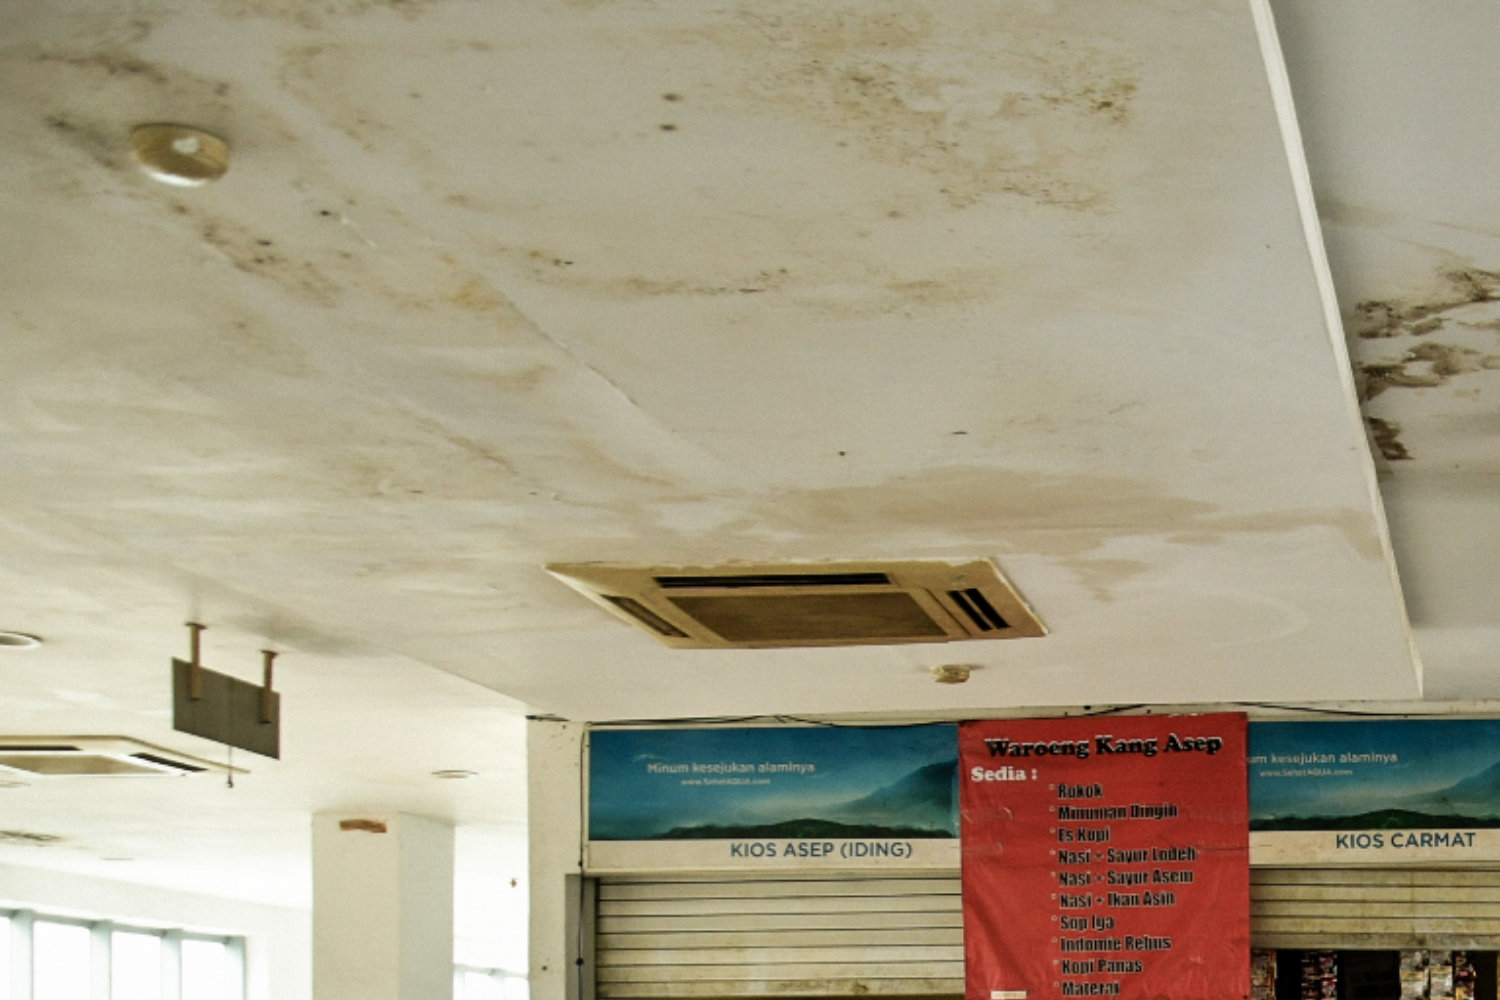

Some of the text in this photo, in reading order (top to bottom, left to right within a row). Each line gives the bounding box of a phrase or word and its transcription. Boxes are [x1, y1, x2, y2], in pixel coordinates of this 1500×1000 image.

[984, 733, 1223, 758] Waroeng Kang Asep
[1272, 753, 1335, 765] kesejukan
[1339, 752, 1398, 765] alaminya
[647, 761, 816, 775] Minum kesejukan alaminya
[971, 766, 1027, 782] Sedia
[1057, 784, 1104, 799] Rokok
[1057, 803, 1179, 821] Minuman Dingin
[1057, 826, 1110, 842] Es Kopi
[1336, 832, 1476, 849] KIOS CARMAT
[730, 842, 913, 859] KIOS ASEP (IDING)
[1058, 849, 1092, 864] Nasi
[1107, 848, 1149, 864] Sayur
[1152, 846, 1198, 861] Lodeh
[1059, 871, 1092, 886] Nasi
[1107, 870, 1149, 886] Sayur
[1152, 869, 1194, 883] Asem
[1059, 892, 1093, 909] Nasi
[1107, 893, 1140, 907] Ikan
[1143, 891, 1176, 906] Asin
[1060, 914, 1115, 931] Sop Iga
[1060, 935, 1172, 952] Indomie Rebus
[1061, 958, 1143, 975] Kopi Panas
[1062, 980, 1121, 996] Materai
